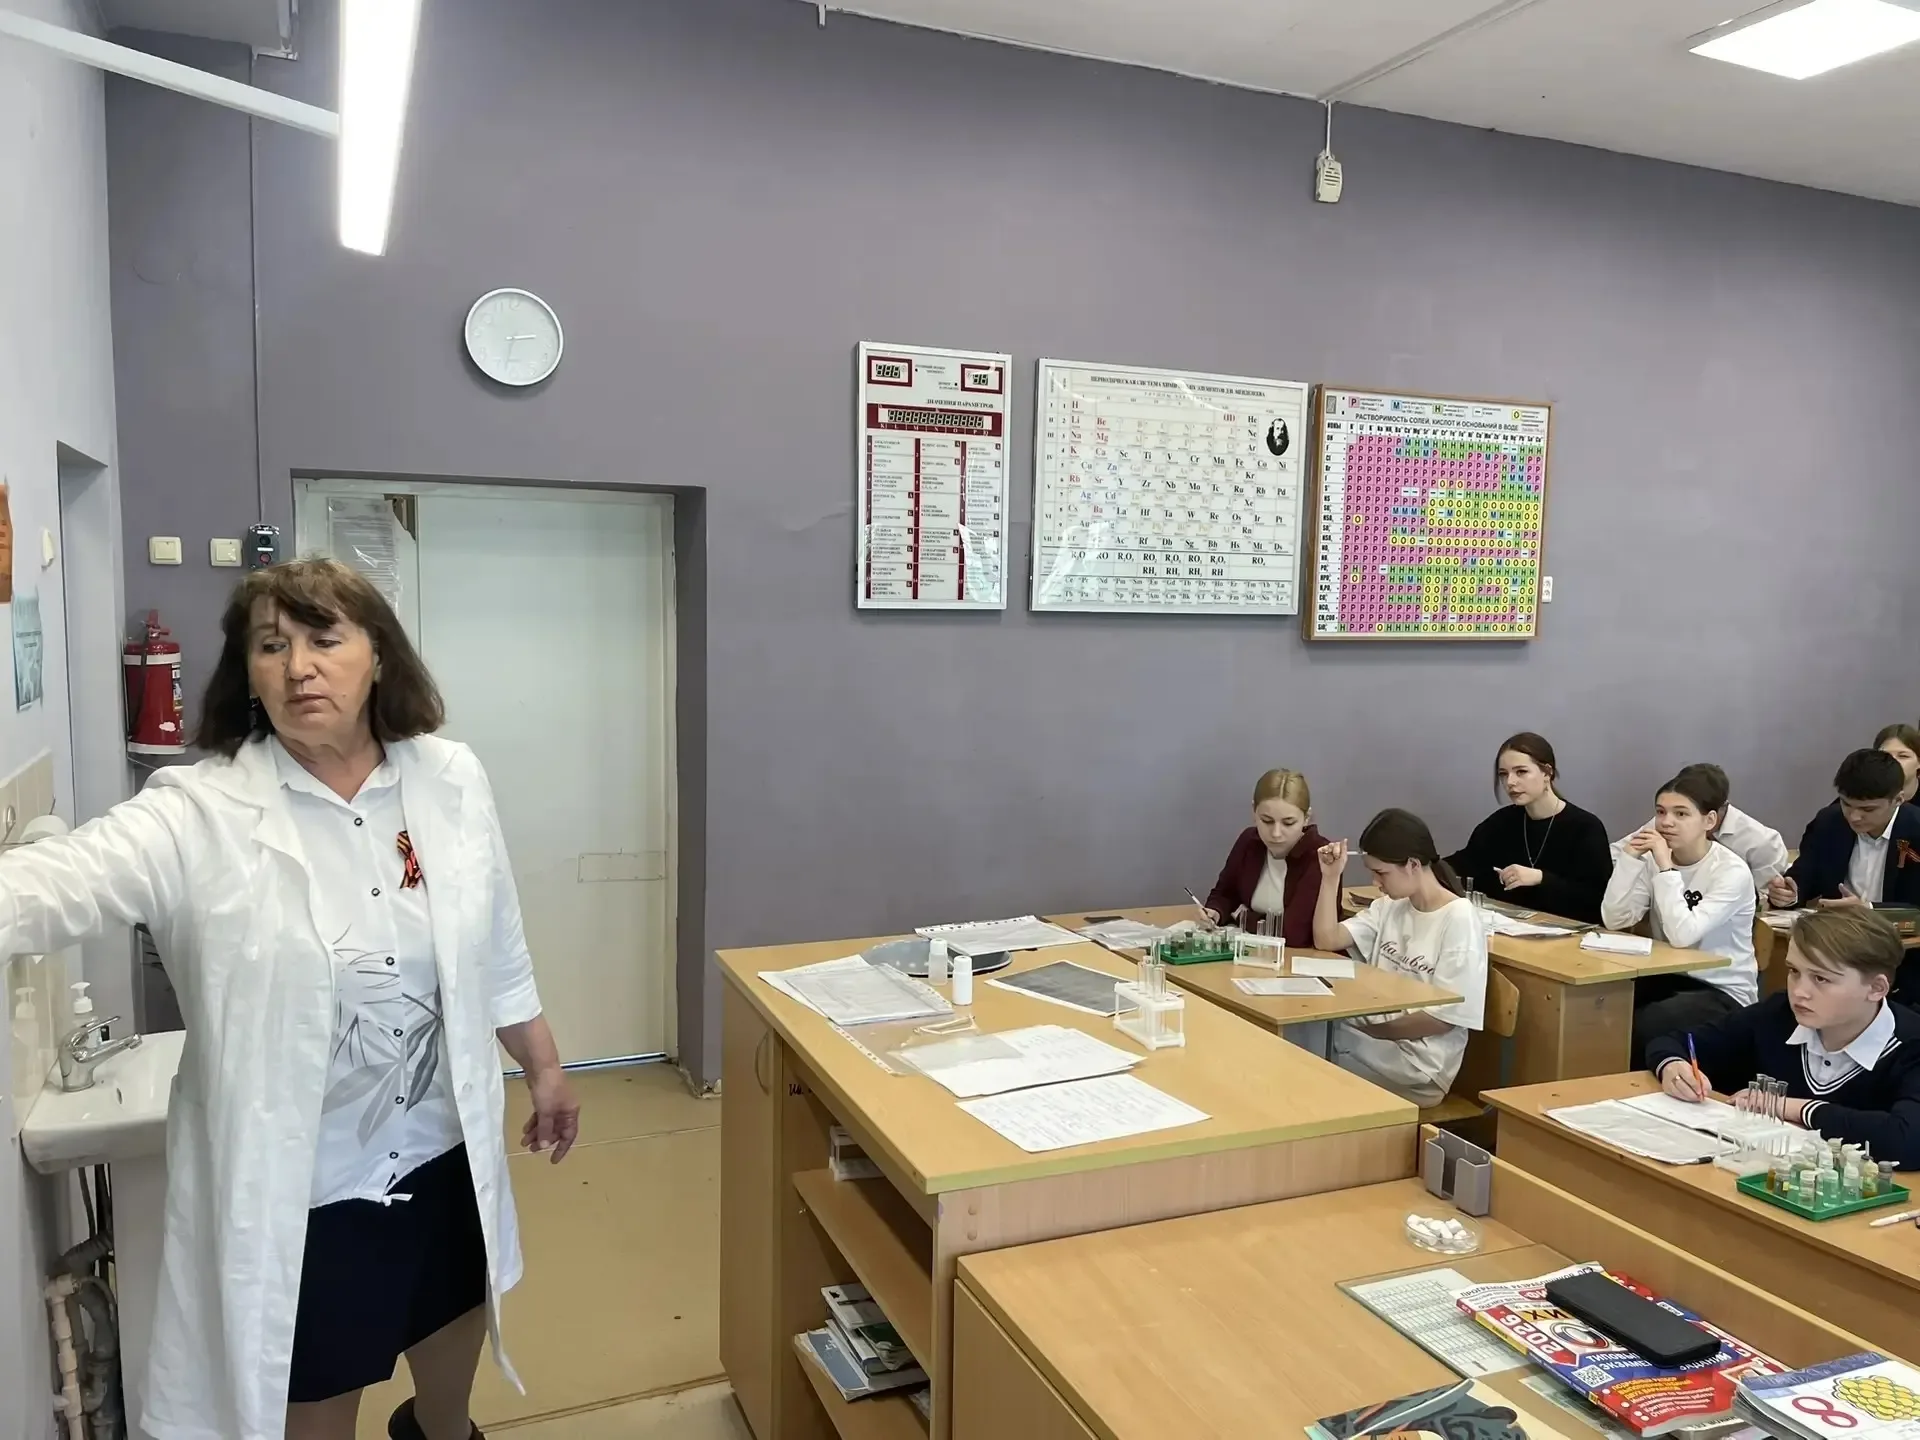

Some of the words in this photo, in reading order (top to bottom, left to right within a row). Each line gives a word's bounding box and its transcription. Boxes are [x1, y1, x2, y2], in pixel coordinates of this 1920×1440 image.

[957, 401, 993, 409] ПАРАМЕТРОВ
[1356, 414, 1408, 423] РАСТВОРИМОСТЬ
[1409, 416, 1431, 424] СОЛЕЙ,
[1501, 1310, 1563, 1354] 2026
[1792, 1396, 1858, 1428] 8
